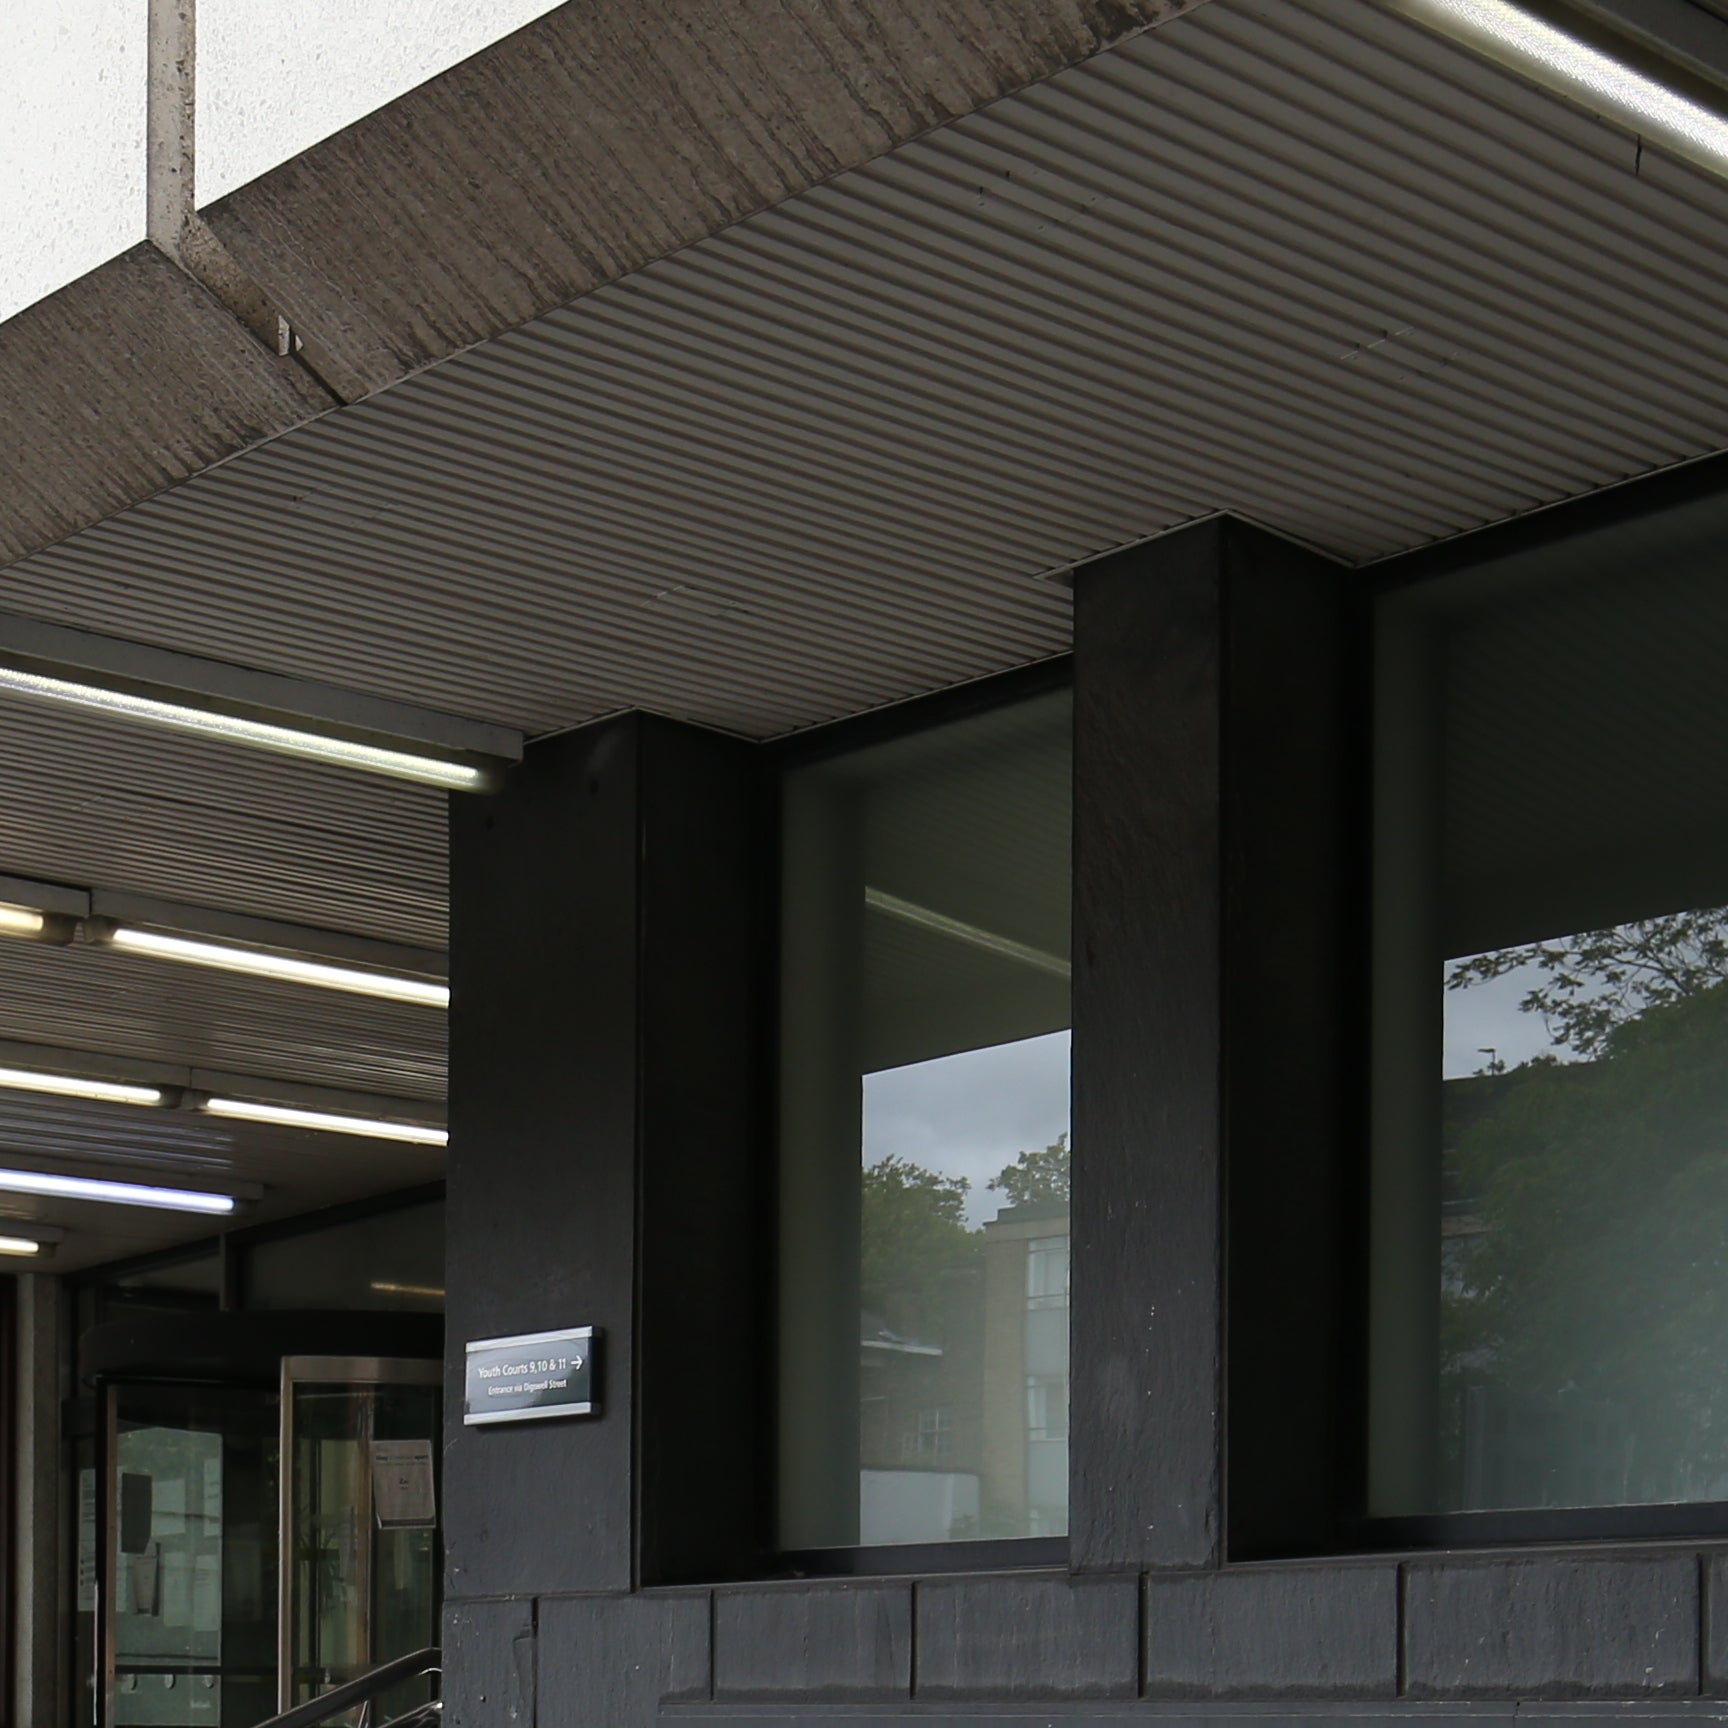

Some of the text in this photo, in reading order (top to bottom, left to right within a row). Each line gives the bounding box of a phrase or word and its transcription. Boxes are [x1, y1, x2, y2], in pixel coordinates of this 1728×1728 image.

[478, 1365, 501, 1379] Youth
[502, 1363, 529, 1376] Courts
[549, 1359, 556, 1370] &
[558, 1358, 566, 1369] 11
[488, 1385, 513, 1395] Entrance
